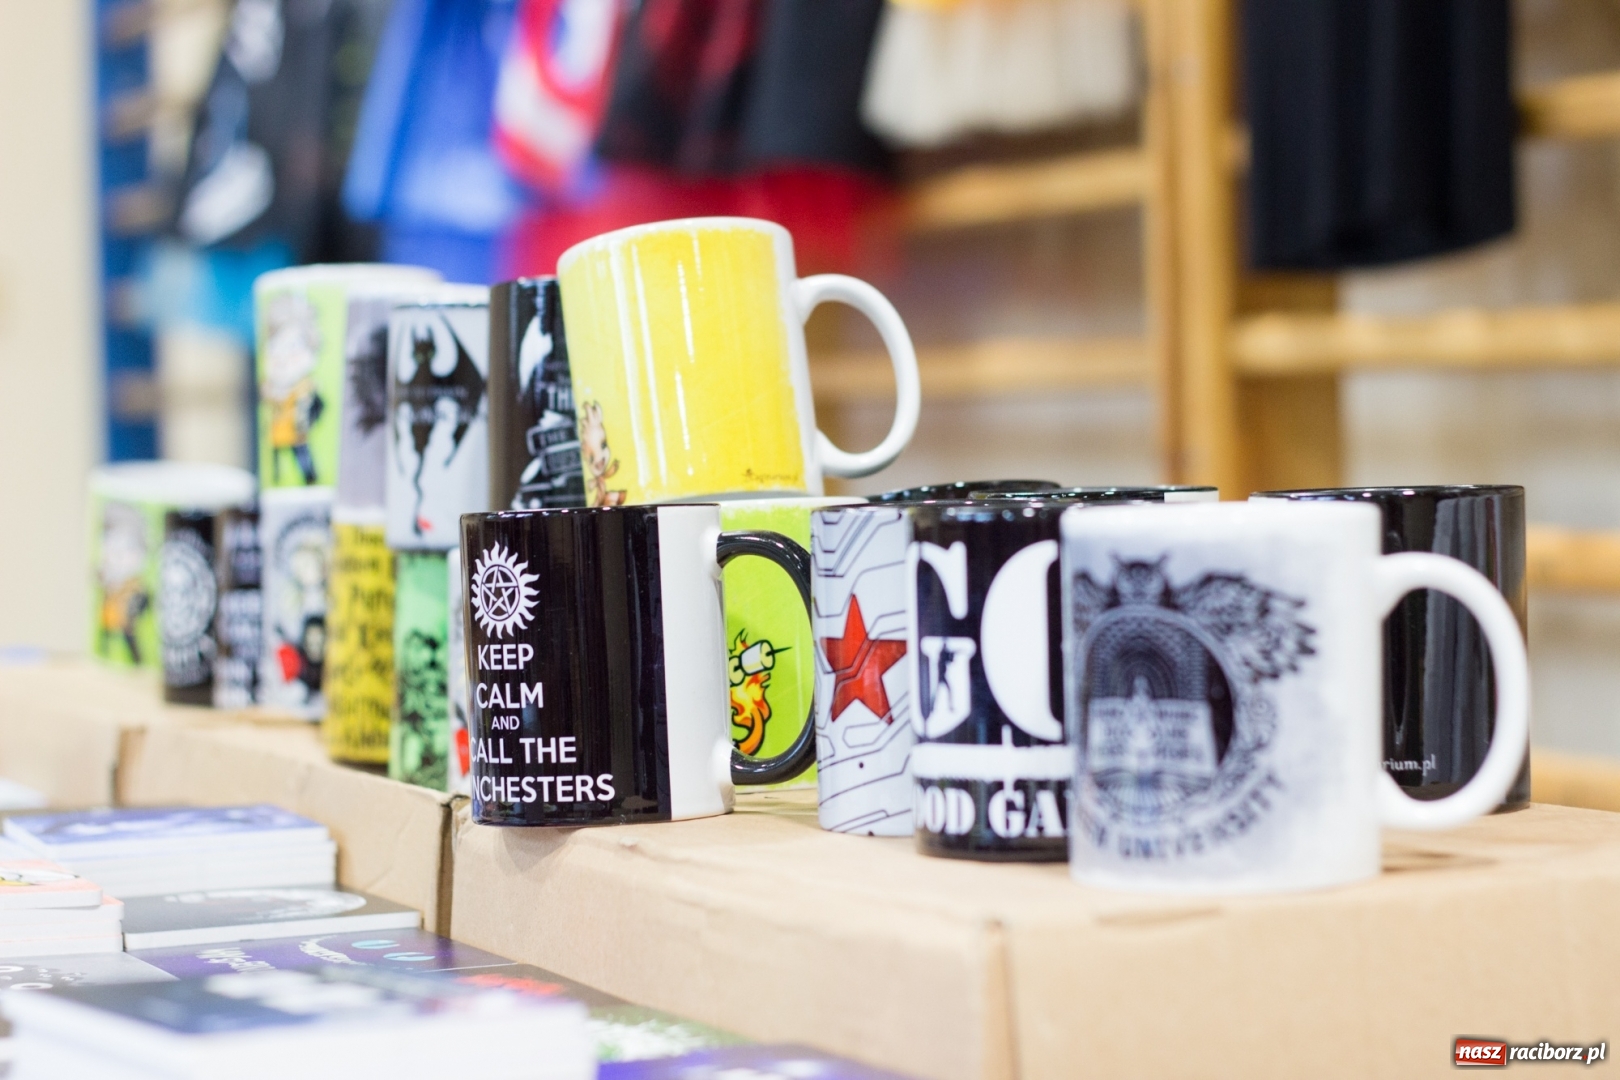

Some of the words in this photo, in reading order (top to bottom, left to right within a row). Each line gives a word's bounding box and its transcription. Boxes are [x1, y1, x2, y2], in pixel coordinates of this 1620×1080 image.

[477, 644, 535, 671] KEEP
[476, 682, 544, 709] CALM
[491, 715, 520, 730] AND
[470, 737, 513, 764] CALL
[519, 736, 577, 764] THE
